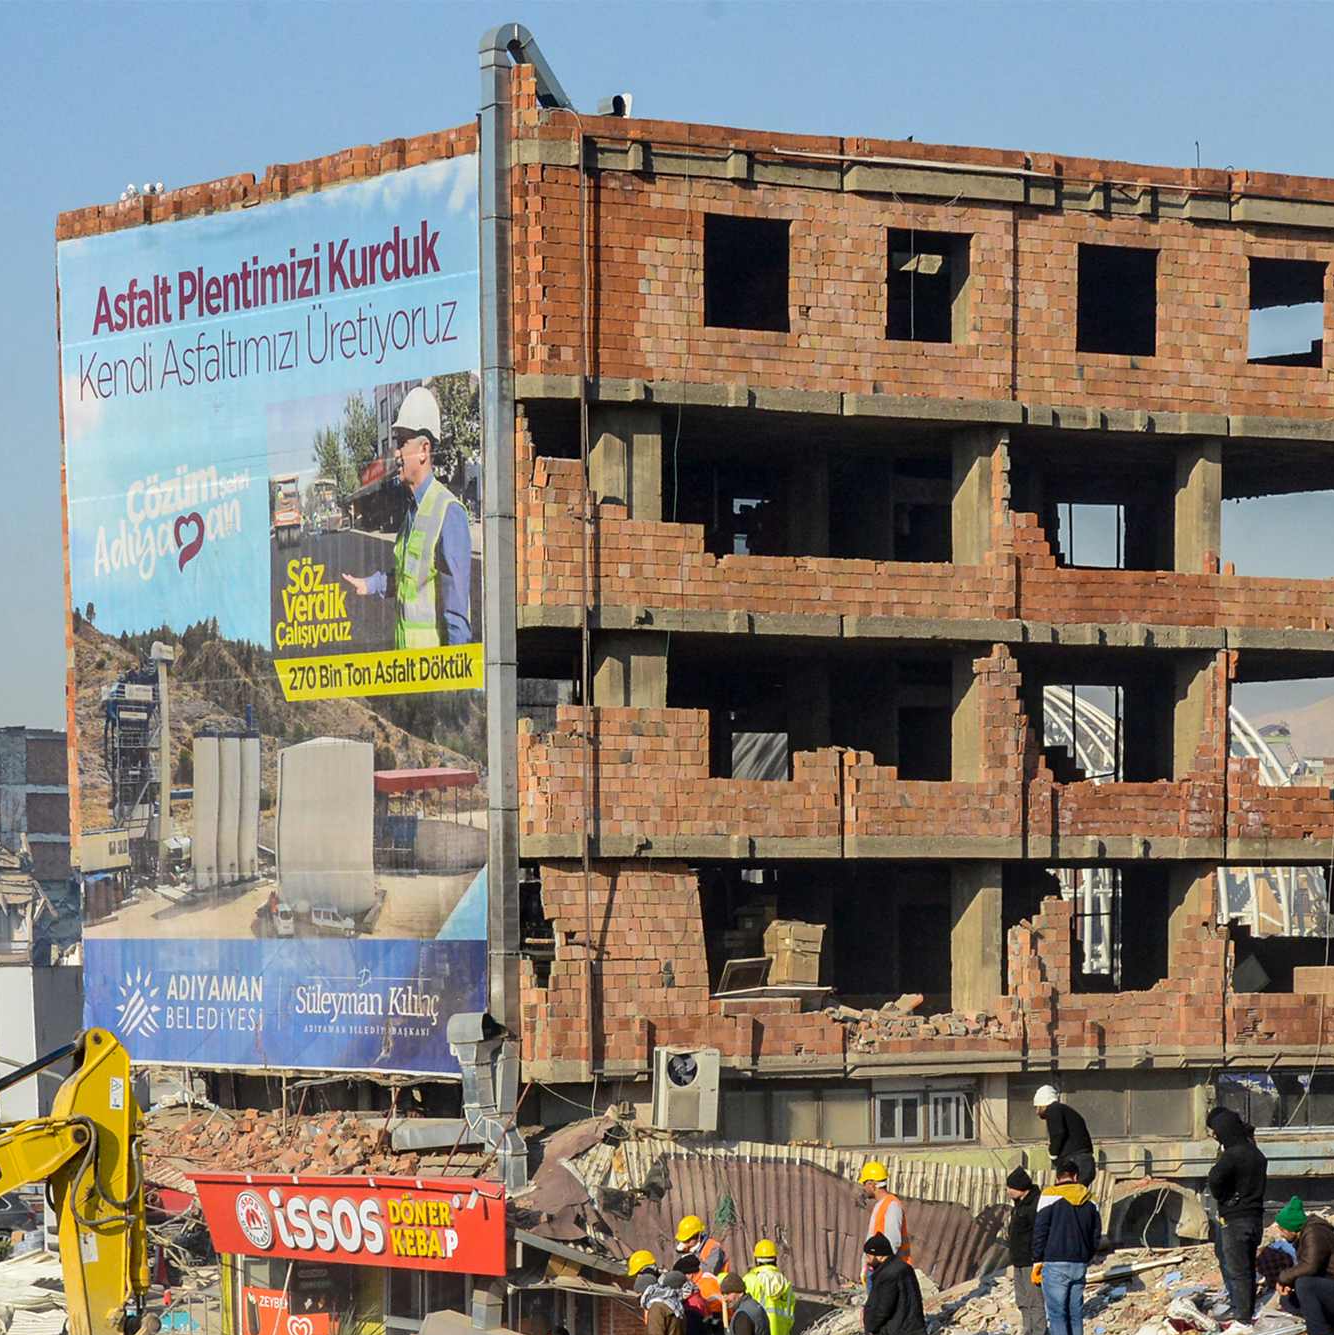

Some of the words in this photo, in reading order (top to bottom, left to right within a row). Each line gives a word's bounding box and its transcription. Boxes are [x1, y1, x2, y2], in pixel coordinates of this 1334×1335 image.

[92, 276, 171, 336] Asfalt
[178, 242, 320, 321] Plentimizi
[328, 220, 441, 294] Kurduk
[78, 341, 153, 401] Kendi
[160, 324, 300, 390] Asfaltımızı
[306, 299, 458, 366] Üretiyoruz
[127, 464, 218, 529] Çözüm
[286, 557, 324, 594] Söz
[282, 584, 348, 622] Verdik
[274, 614, 352, 651] Çalışıyoruz
[288, 664, 317, 690] 270
[320, 662, 342, 688] Bin
[345, 661, 372, 687] Ton
[374, 657, 416, 685] Asfalt
[418, 653, 473, 683] Döktük
[166, 975, 263, 1002] ADIYAMAN
[295, 985, 383, 1023] Süleyman
[166, 1006, 264, 1032] BELEDİYESİ
[387, 1193, 453, 1227] DÖNER
[390, 1228, 458, 1259] KEBAP
